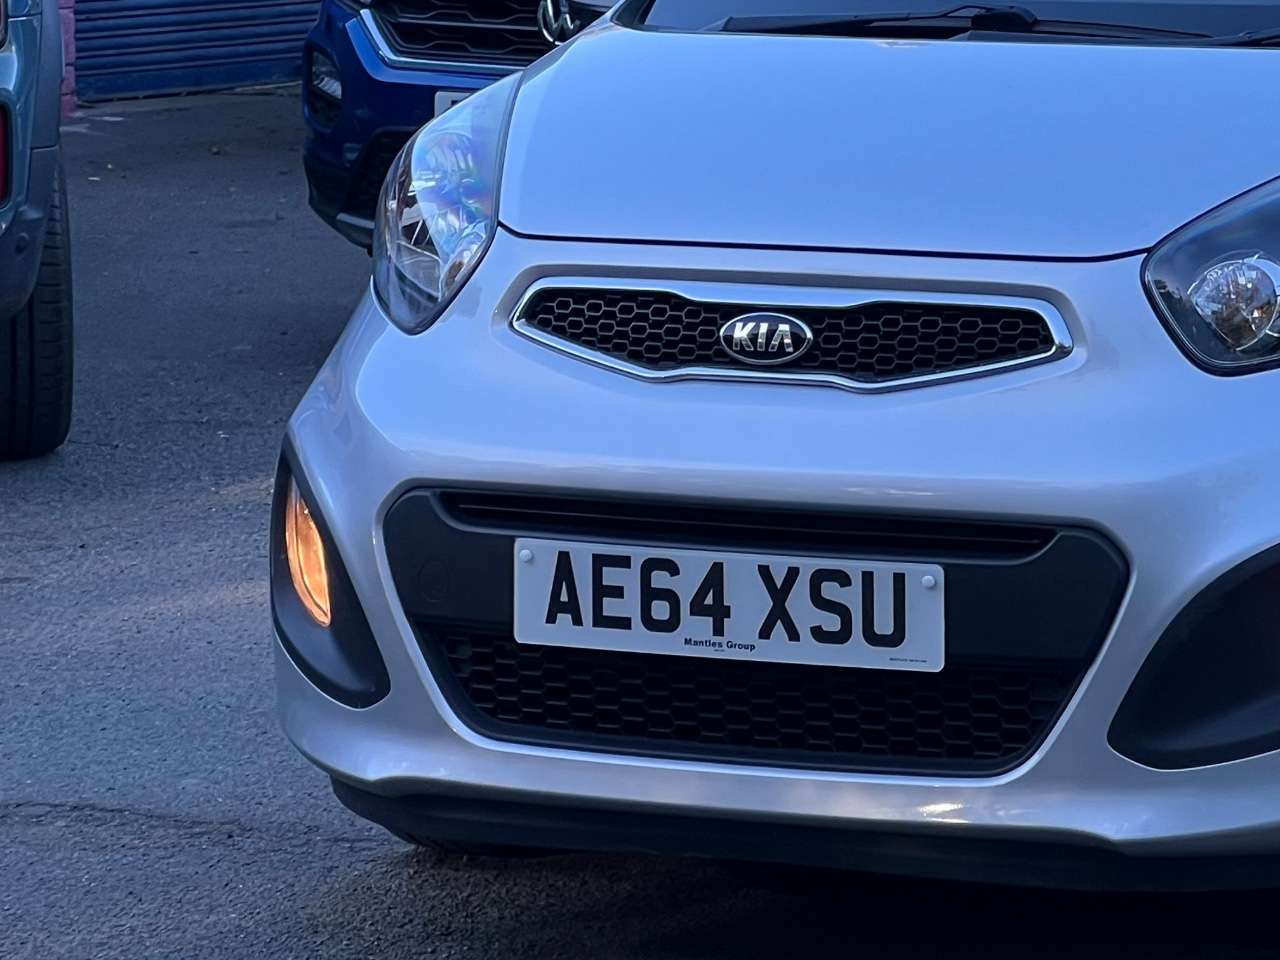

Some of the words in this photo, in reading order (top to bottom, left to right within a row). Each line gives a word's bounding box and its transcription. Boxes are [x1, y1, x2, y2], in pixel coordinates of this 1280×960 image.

[732, 321, 794, 353] KIA
[545, 550, 731, 637] AE64
[757, 564, 907, 649] XSU
[684, 637, 723, 648] Mantles
[726, 640, 756, 653] Group
